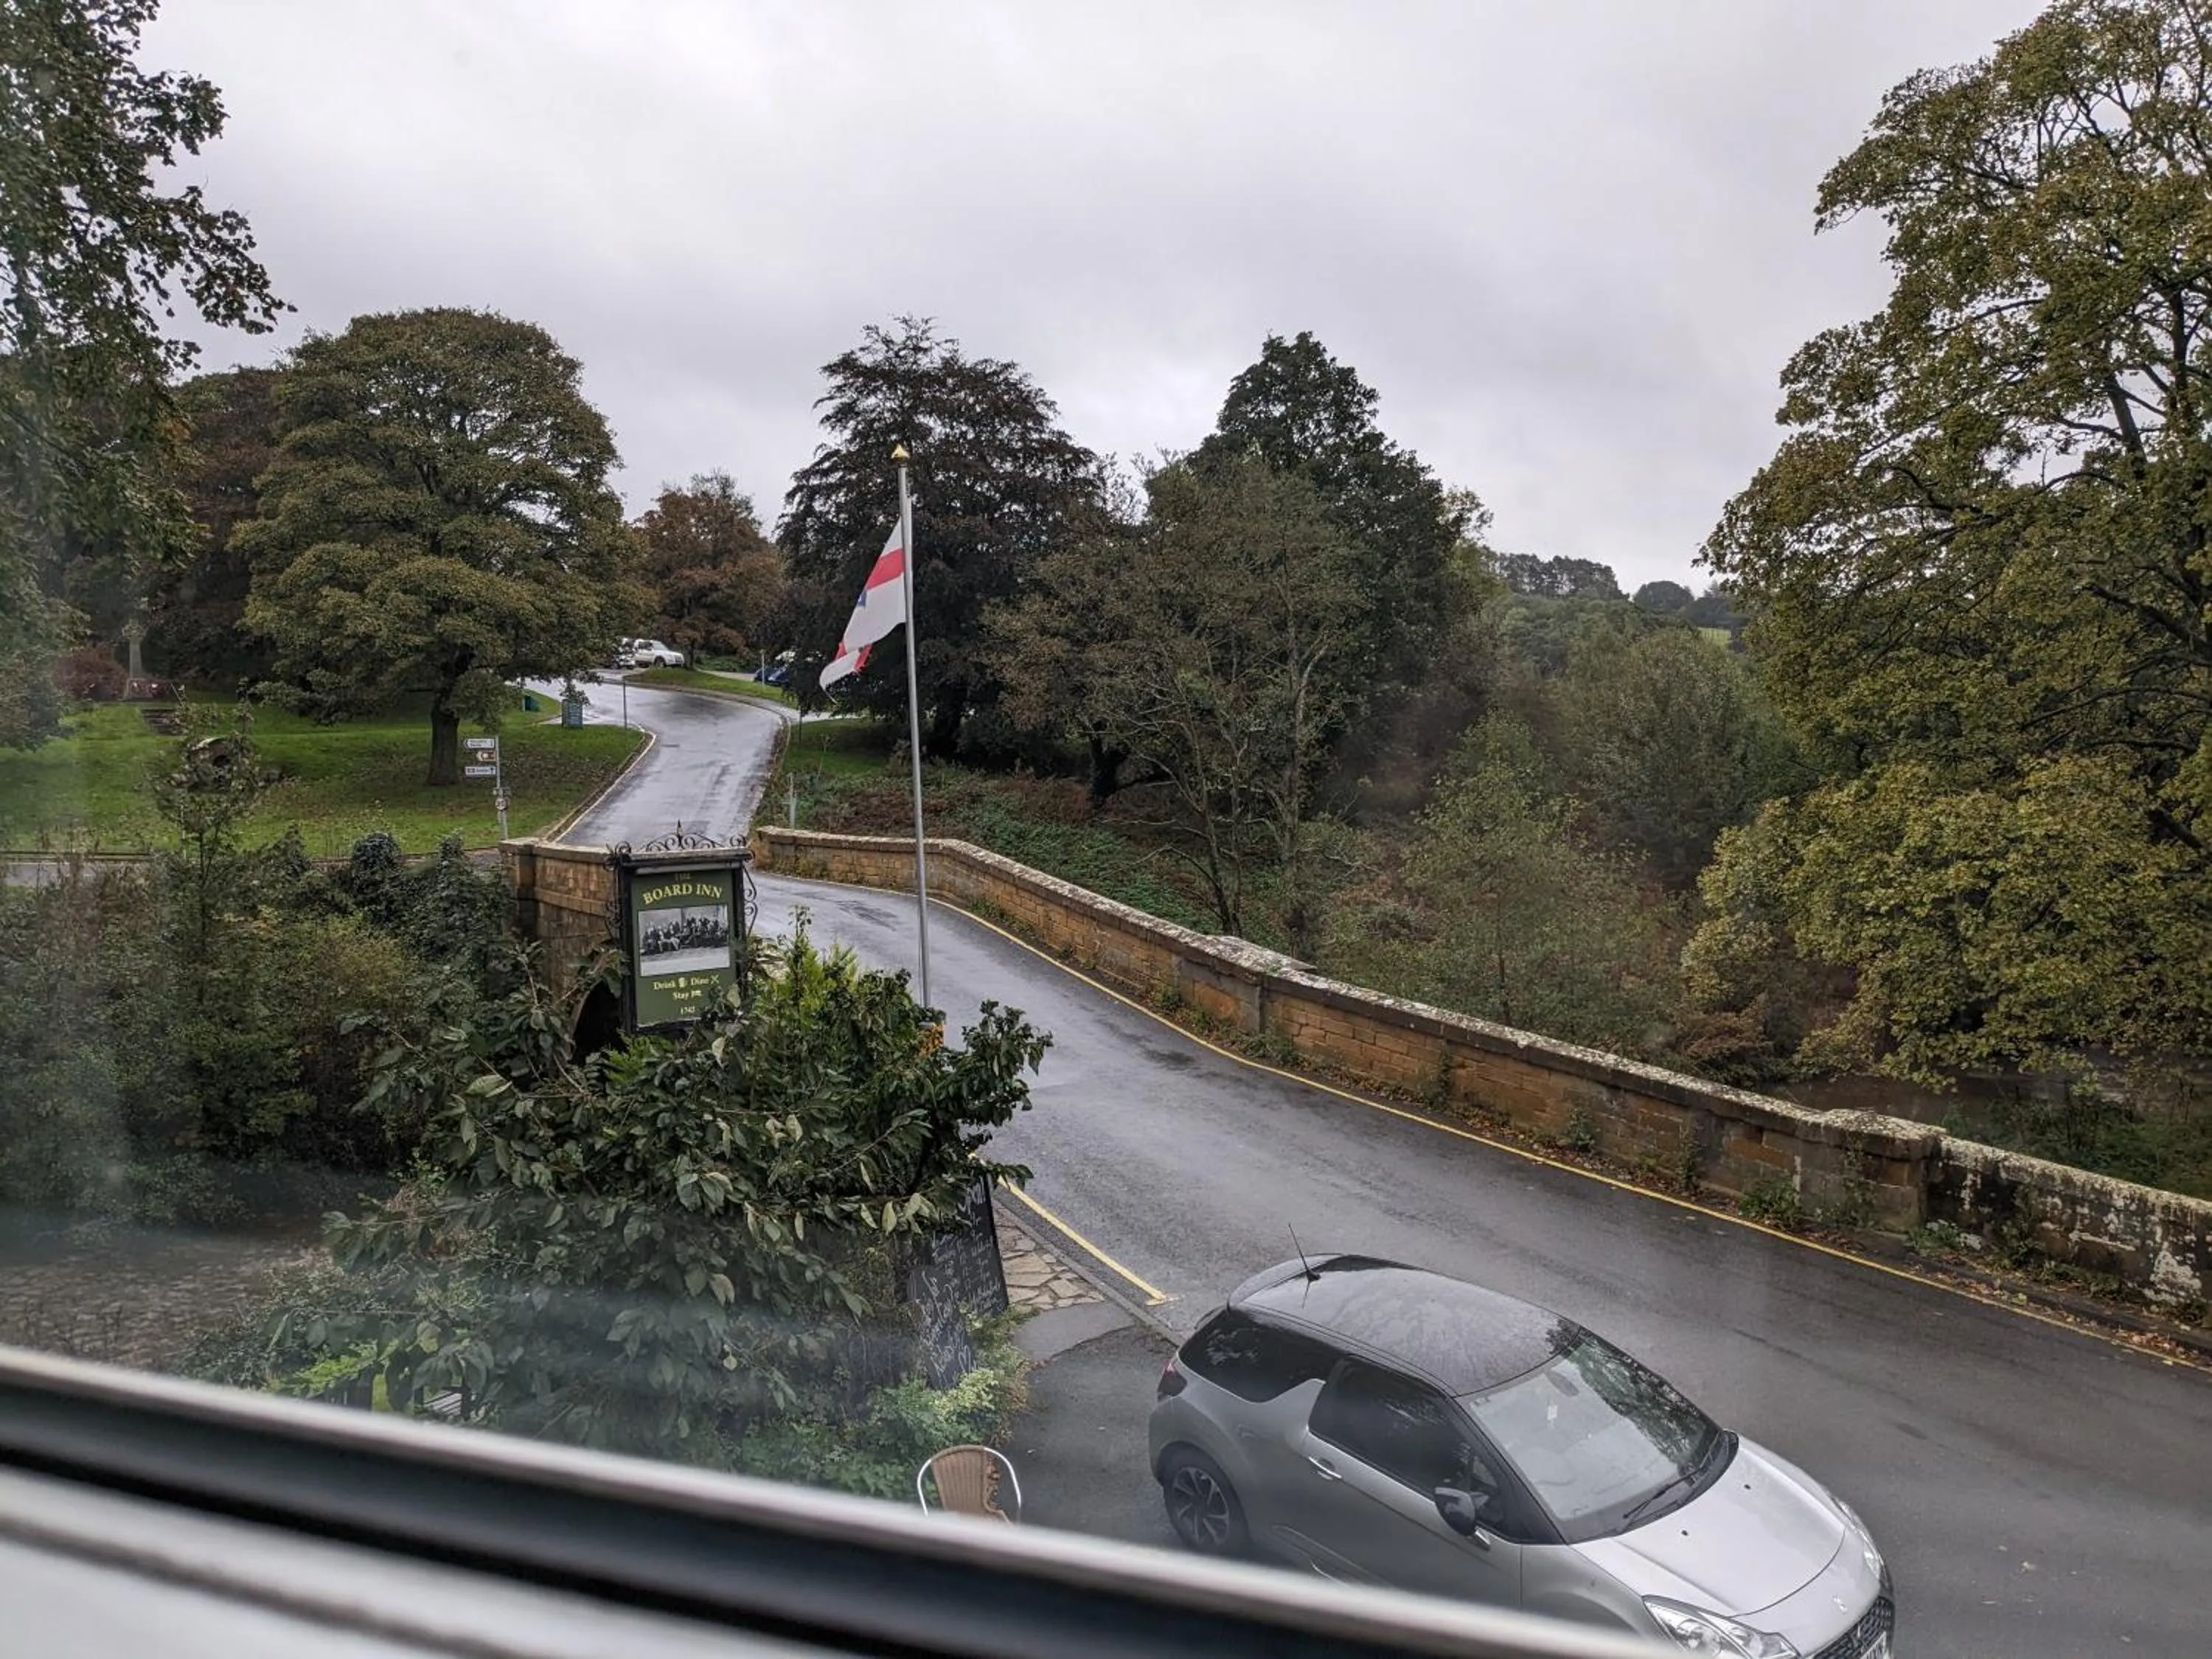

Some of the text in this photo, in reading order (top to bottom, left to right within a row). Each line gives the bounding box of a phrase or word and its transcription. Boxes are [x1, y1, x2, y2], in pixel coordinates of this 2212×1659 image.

[643, 883, 722, 905] BOARD INN
[653, 978, 709, 990] Drink Dine
[672, 992, 689, 1001] Stay
